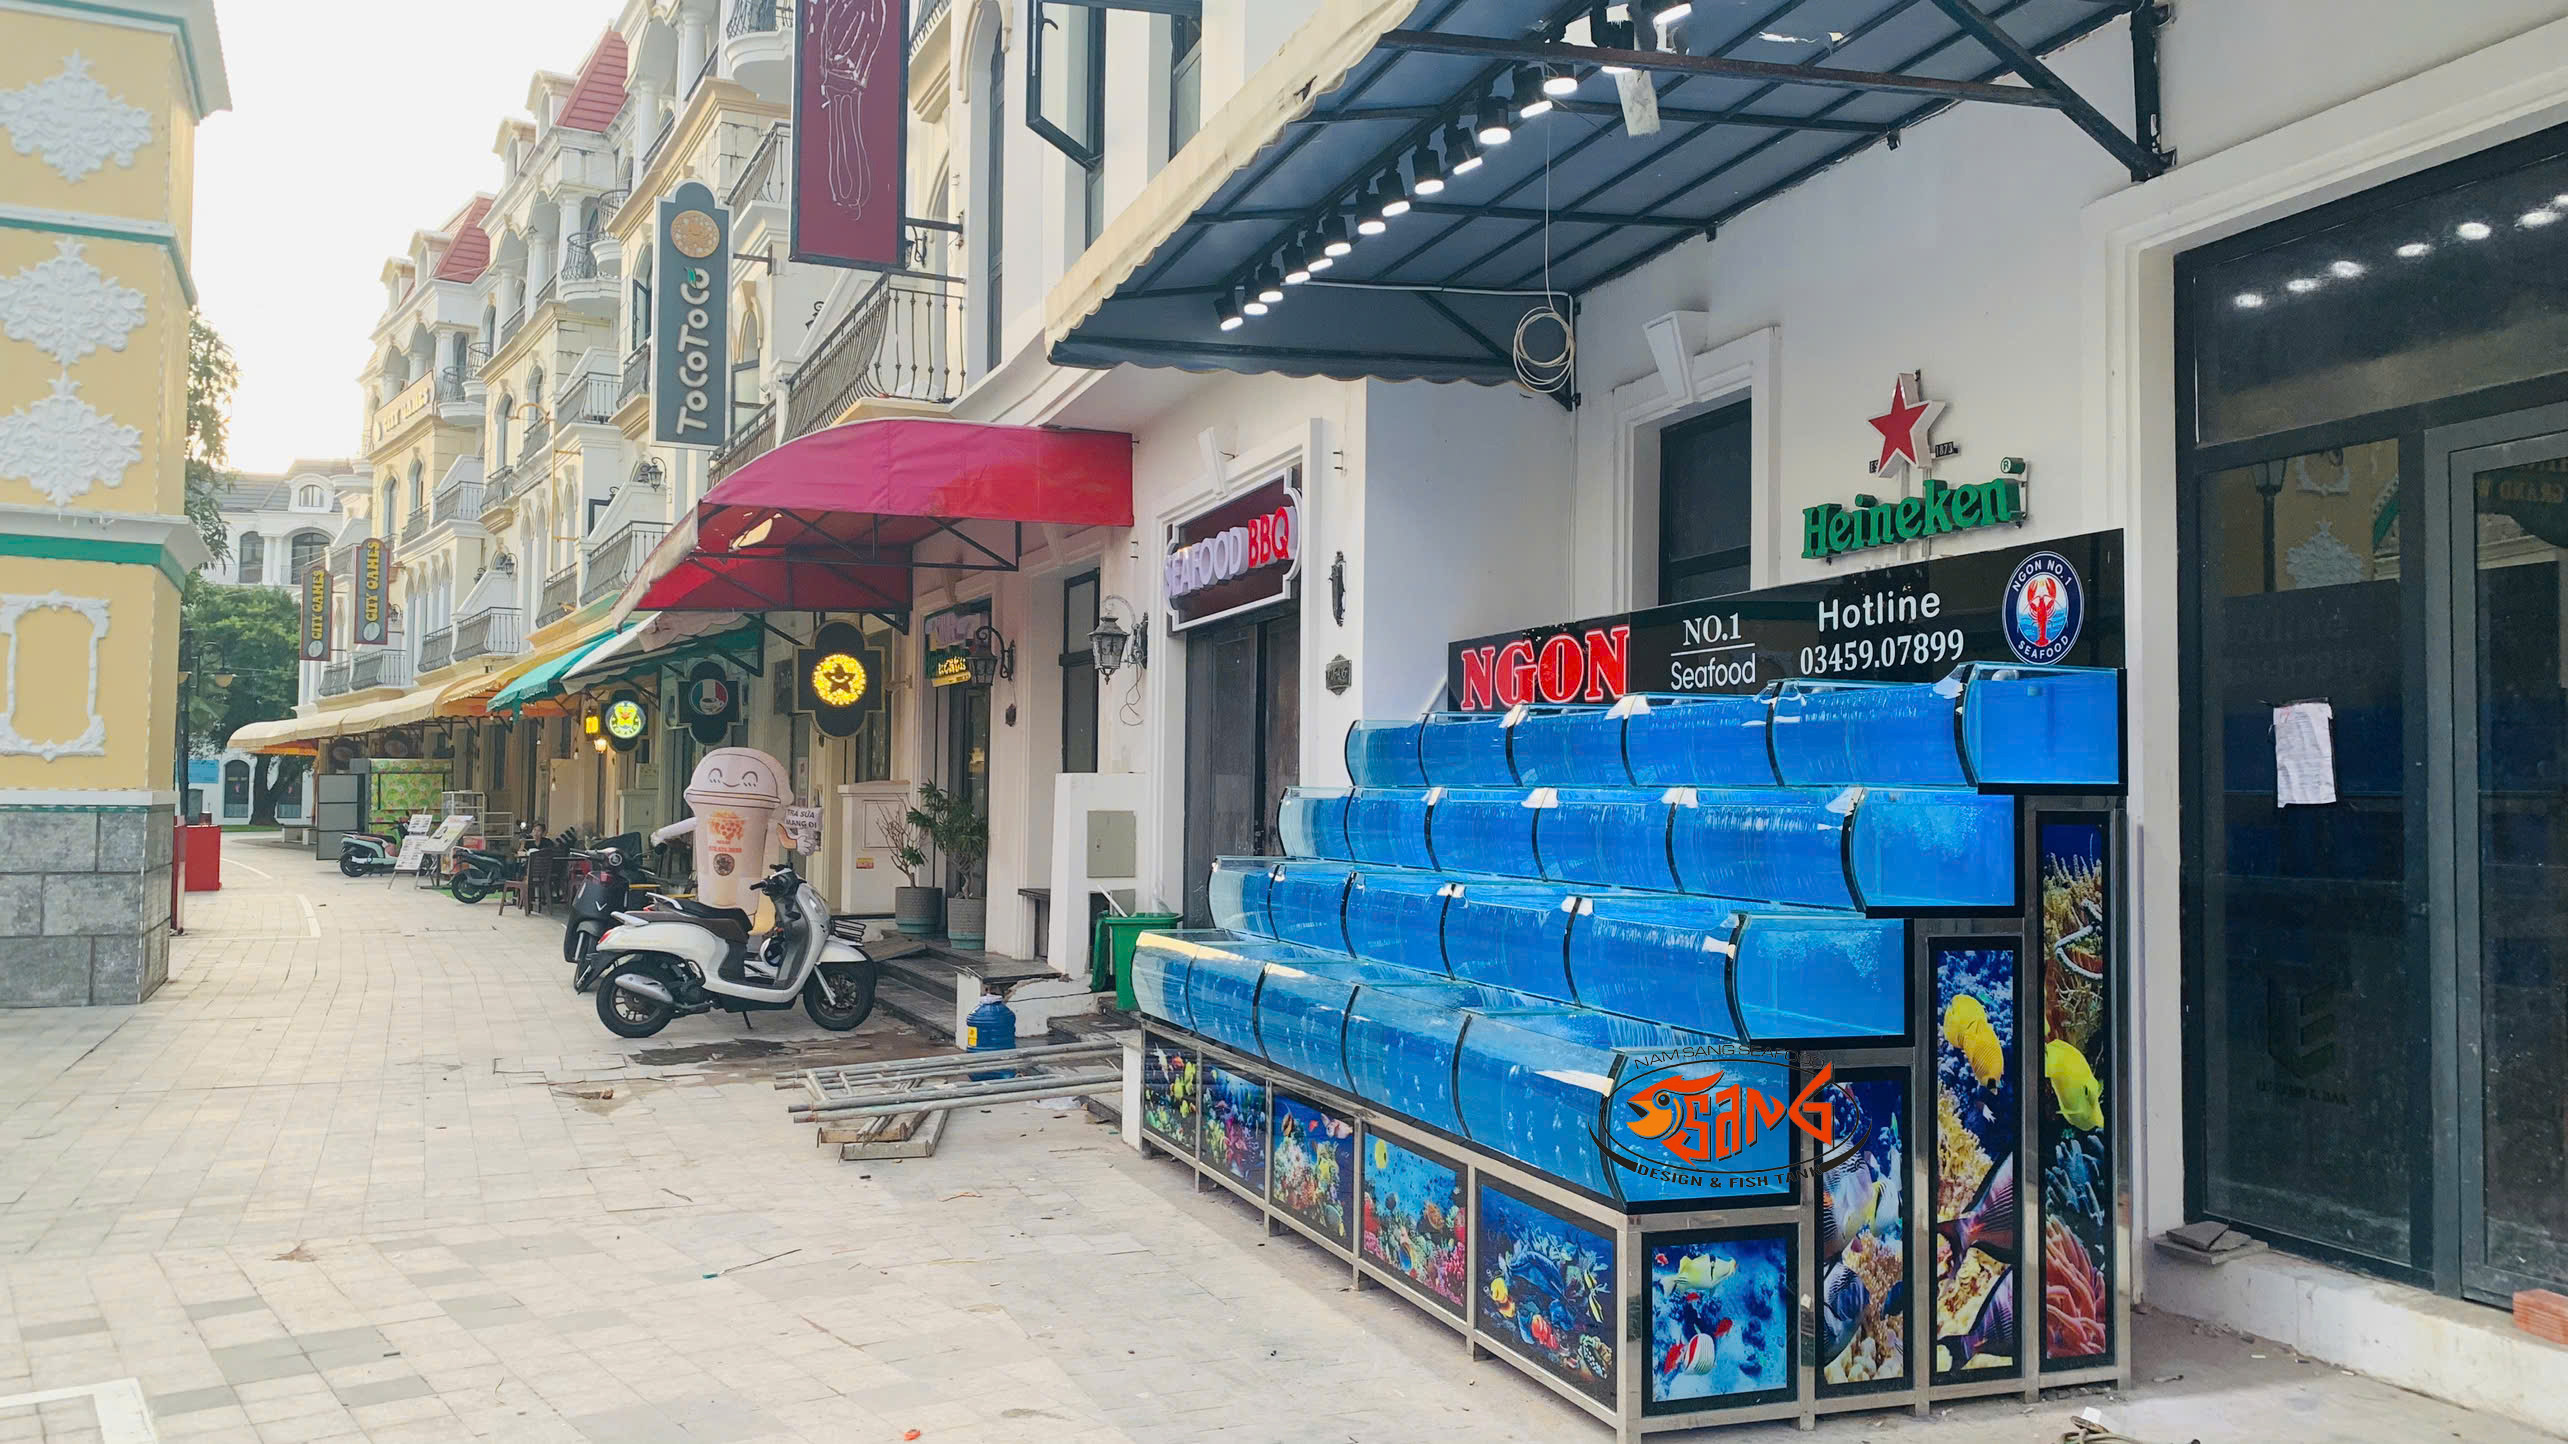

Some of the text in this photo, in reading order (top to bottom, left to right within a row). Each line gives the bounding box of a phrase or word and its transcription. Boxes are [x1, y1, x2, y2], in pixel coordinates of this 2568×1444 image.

[1935, 442, 1954, 458] 1873
[1801, 478, 2020, 560] Heineken
[1164, 506, 1296, 597] SEAFOOD BBQ
[2012, 560, 2042, 592] NGON
[1682, 612, 1741, 647] NO.1
[1818, 591, 1941, 633] Hotline
[1460, 624, 1630, 712] NGON
[1799, 629, 1965, 677] 03459.07899
[2018, 635, 2069, 660] SEAFOOD
[1670, 652, 1757, 692] Seafood
